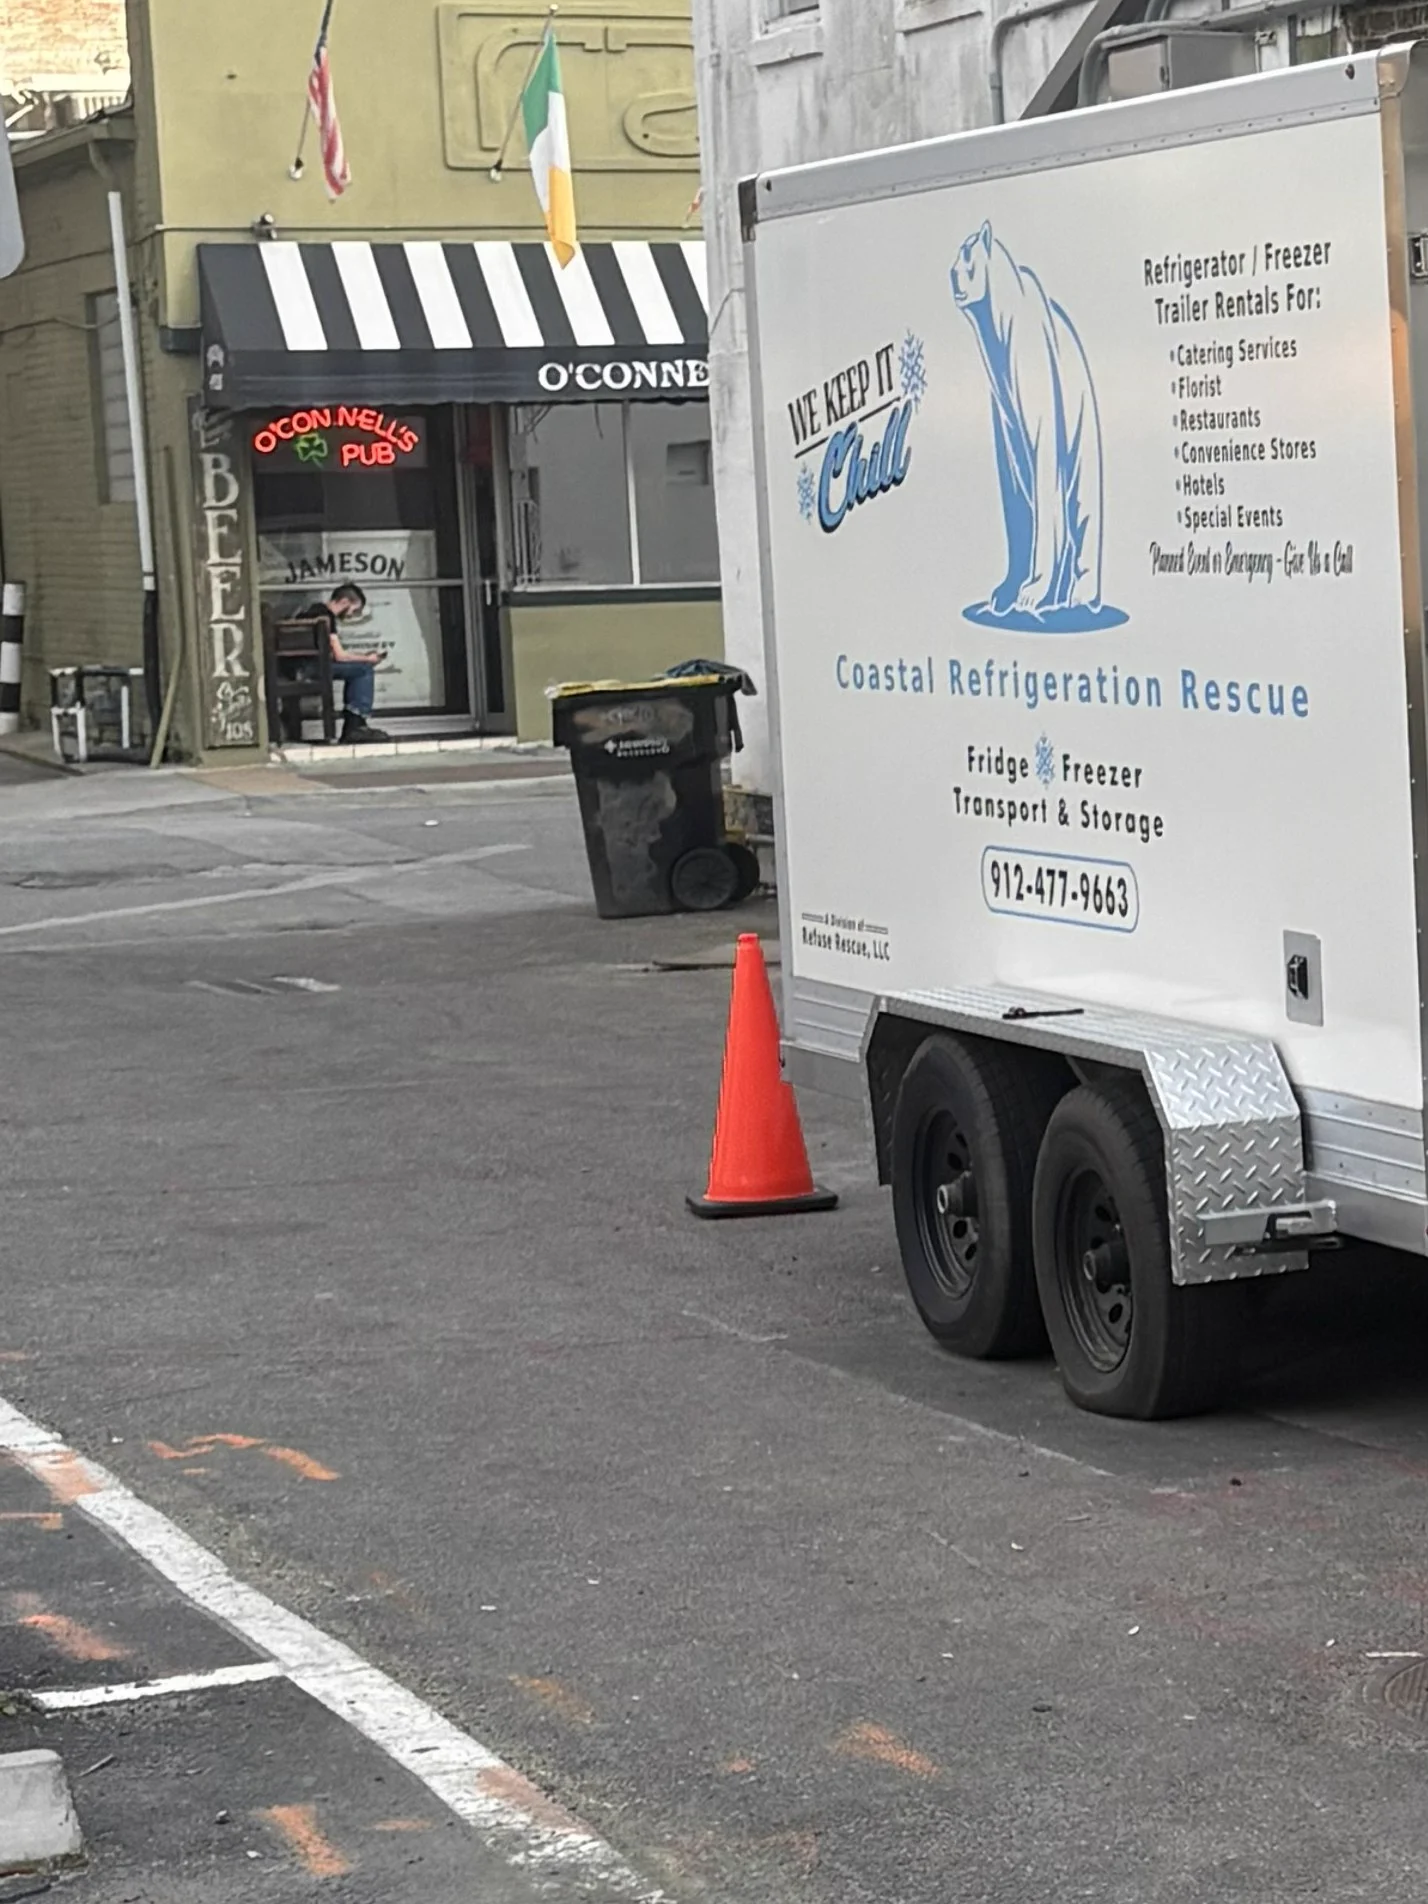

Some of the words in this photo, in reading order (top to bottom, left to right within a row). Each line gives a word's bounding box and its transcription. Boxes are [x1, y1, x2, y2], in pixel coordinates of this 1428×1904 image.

[1144, 250, 1246, 289] Refrigerator
[1252, 245, 1257, 276] /
[1264, 242, 1331, 271] Freezer
[1154, 294, 1209, 325] Trailer
[1215, 285, 1279, 319] Rentals
[1286, 283, 1321, 312] For:
[1177, 340, 1234, 369] Catering
[1238, 335, 1297, 362] Services
[787, 389, 821, 446] WE
[823, 359, 870, 427] KEEP
[875, 343, 894, 397] IT
[1178, 374, 1222, 399] Florist
[1180, 407, 1261, 431] Restaurants
[341, 441, 396, 467] PUB
[817, 396, 912, 534] Chill
[1181, 439, 1266, 464] Convenience
[1270, 437, 1317, 460] Stores
[1182, 472, 1225, 496] Hotels
[1184, 504, 1232, 533] Special
[1236, 505, 1284, 529] Events
[201, 453, 249, 678] BEER
[284, 552, 405, 584] JAMESON
[836, 654, 934, 694] Coastal
[948, 659, 1162, 710] Refrigeration
[1180, 669, 1309, 718] Rescue
[967, 745, 1029, 784] Fridge
[1062, 753, 1142, 788] Freezer
[953, 786, 1047, 827] Transport
[1058, 798, 1070, 826] &
[1080, 799, 1164, 844] Storage
[989, 860, 1129, 919] 912-477-9663
[802, 926, 832, 950] Refuse
[834, 932, 871, 959] Rescue,
[872, 939, 890, 961] LLC
